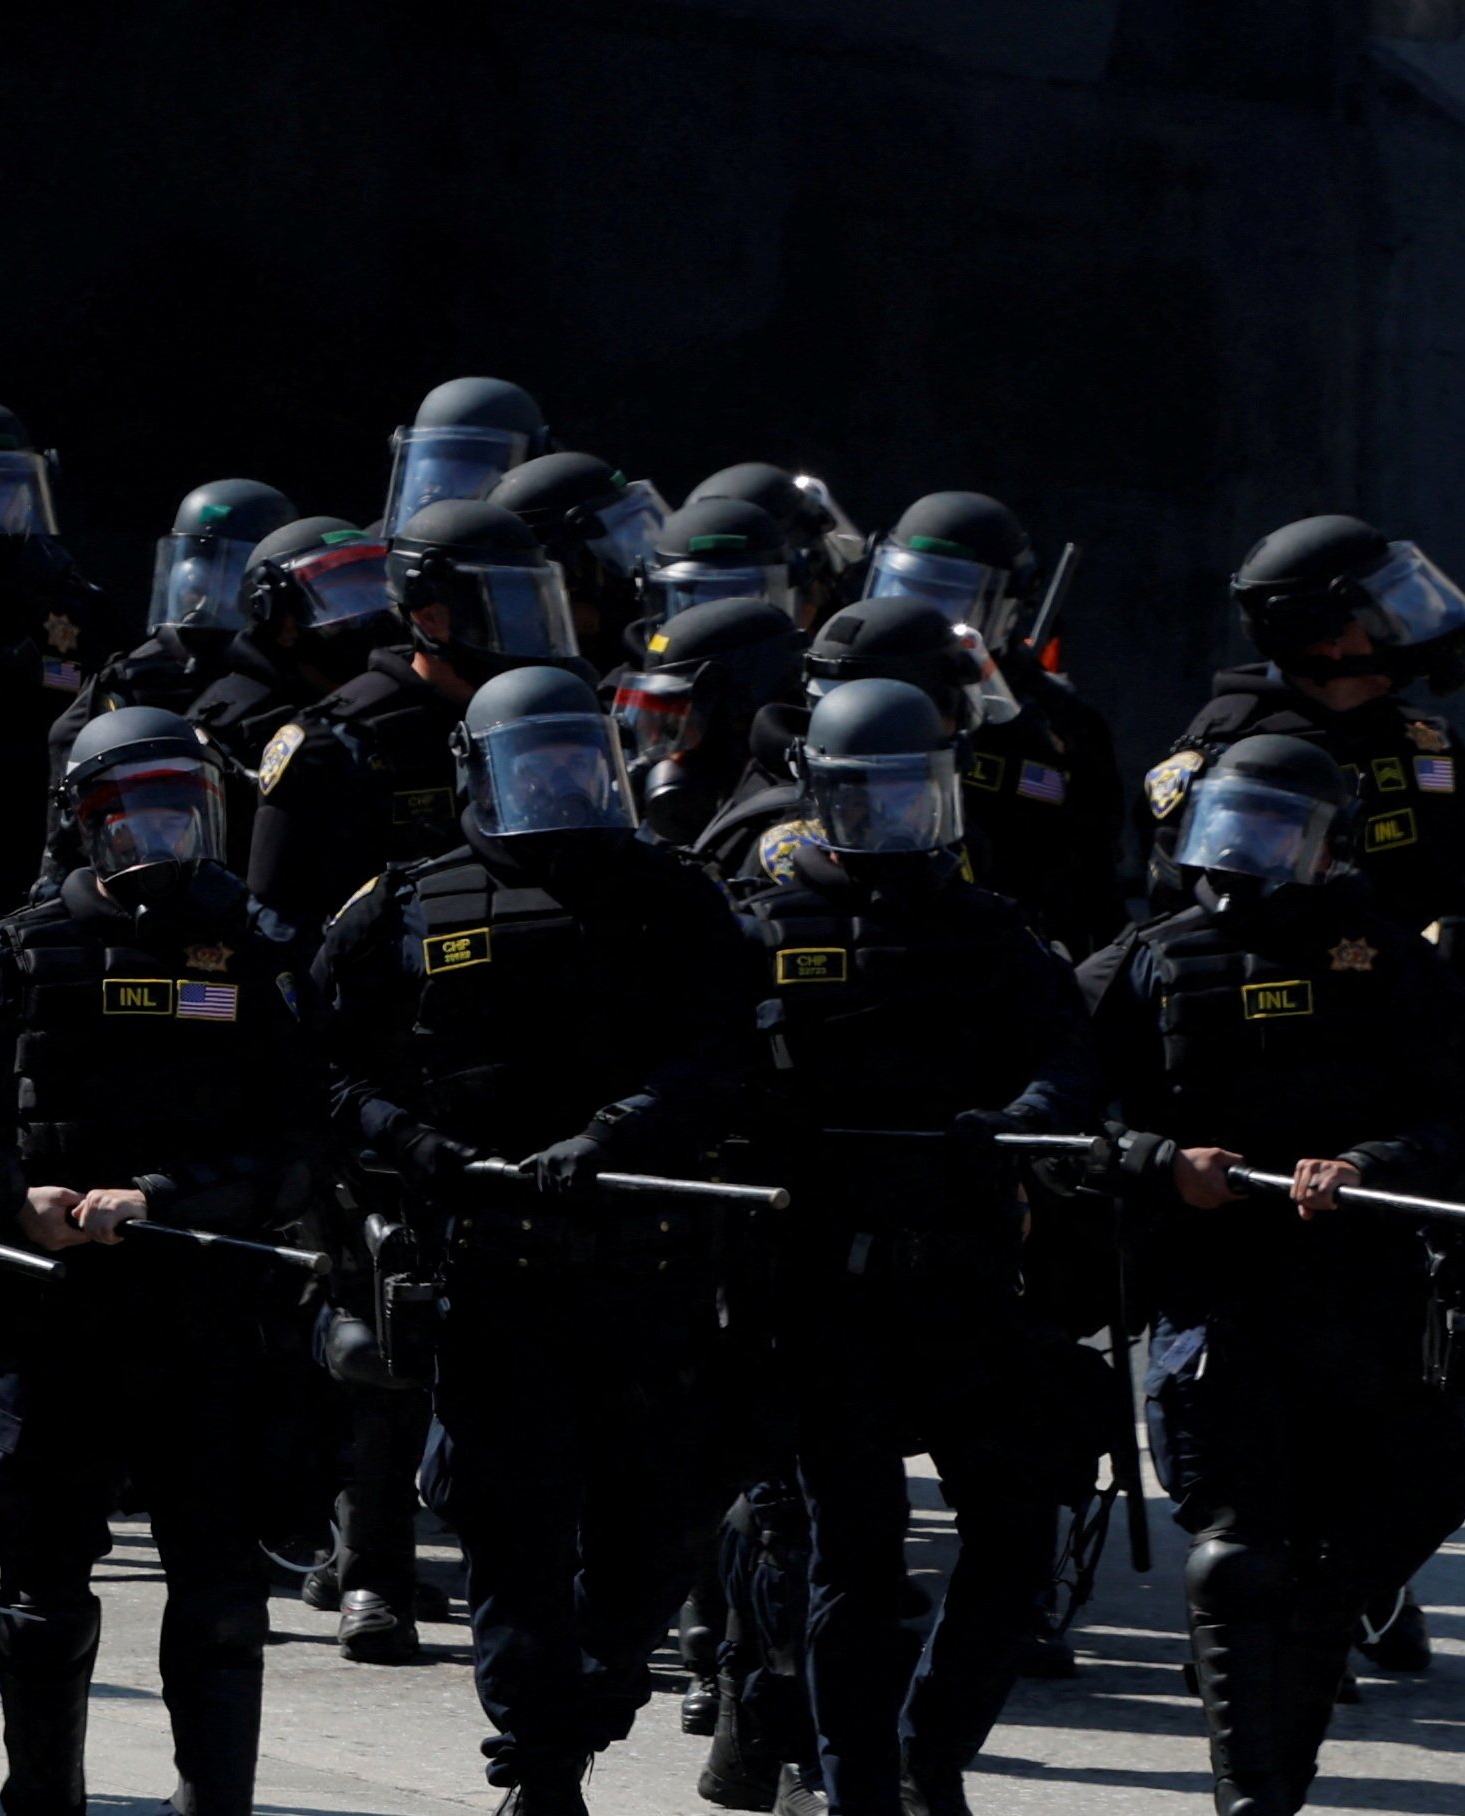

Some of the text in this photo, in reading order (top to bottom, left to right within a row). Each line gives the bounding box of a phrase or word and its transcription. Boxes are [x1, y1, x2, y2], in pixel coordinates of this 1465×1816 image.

[796, 954, 828, 967] CHP
[120, 987, 157, 1007] INL
[1258, 990, 1297, 1010] INL
